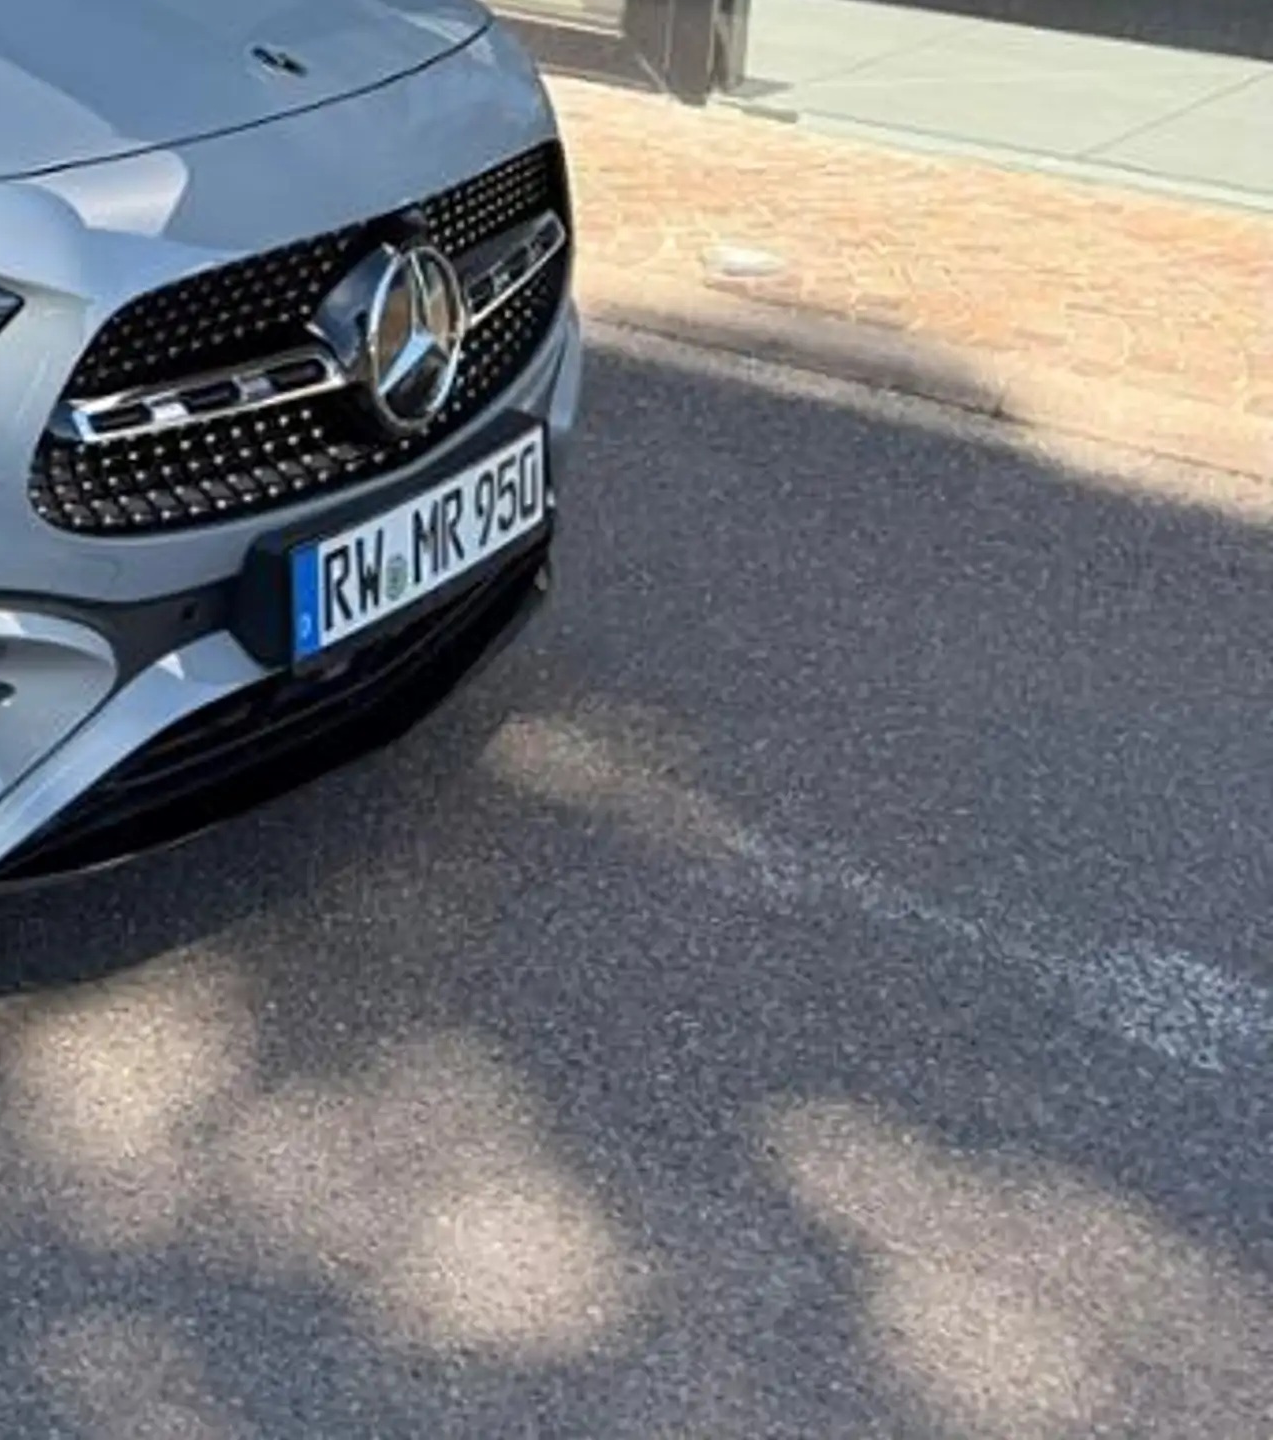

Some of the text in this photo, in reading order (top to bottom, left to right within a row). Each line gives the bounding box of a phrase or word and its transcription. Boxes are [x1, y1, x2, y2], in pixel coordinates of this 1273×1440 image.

[324, 442, 536, 632] RW MR 950
